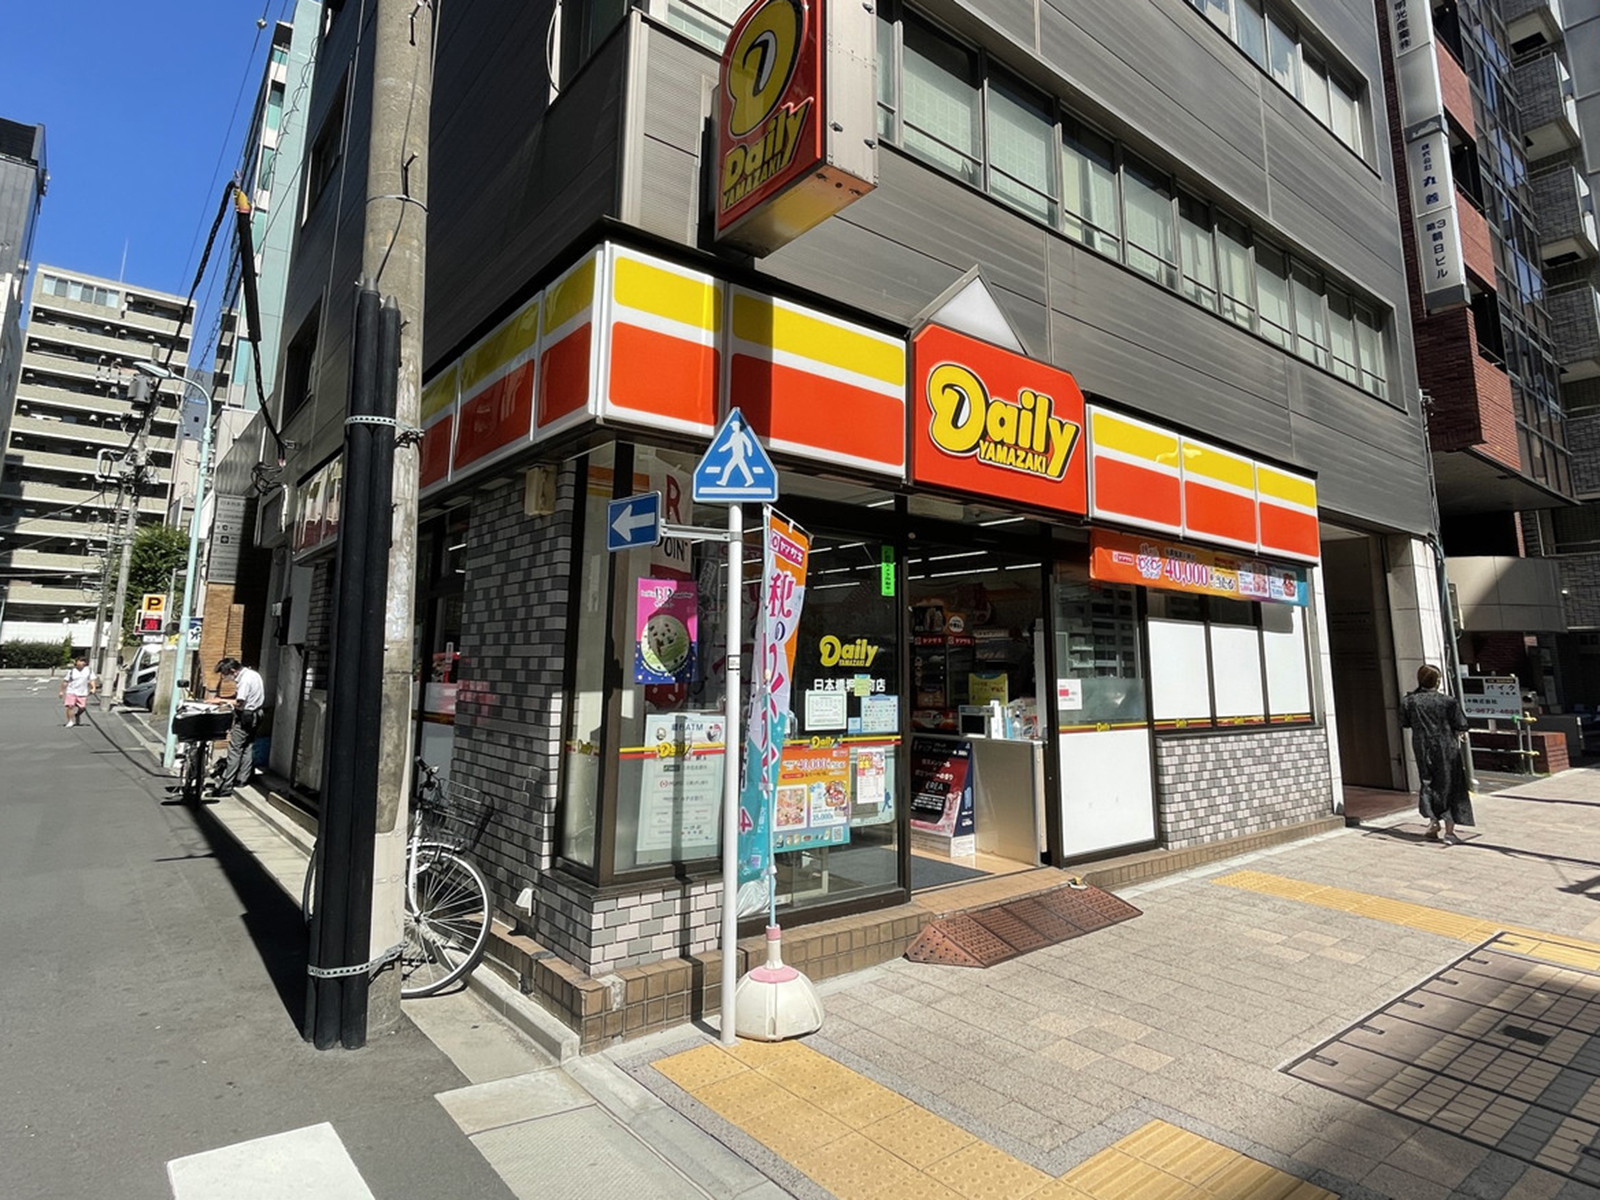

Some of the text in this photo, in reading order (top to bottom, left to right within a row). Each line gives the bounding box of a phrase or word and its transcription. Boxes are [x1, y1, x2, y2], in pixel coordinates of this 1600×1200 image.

[723, 99, 810, 192] Daily
[929, 363, 1079, 478] Daily
[979, 440, 1047, 474] YAMAZAKI
[1165, 558, 1208, 586] 40,000
[147, 597, 162, 610] P
[820, 635, 878, 667] Daily
[657, 741, 693, 759] Daily
